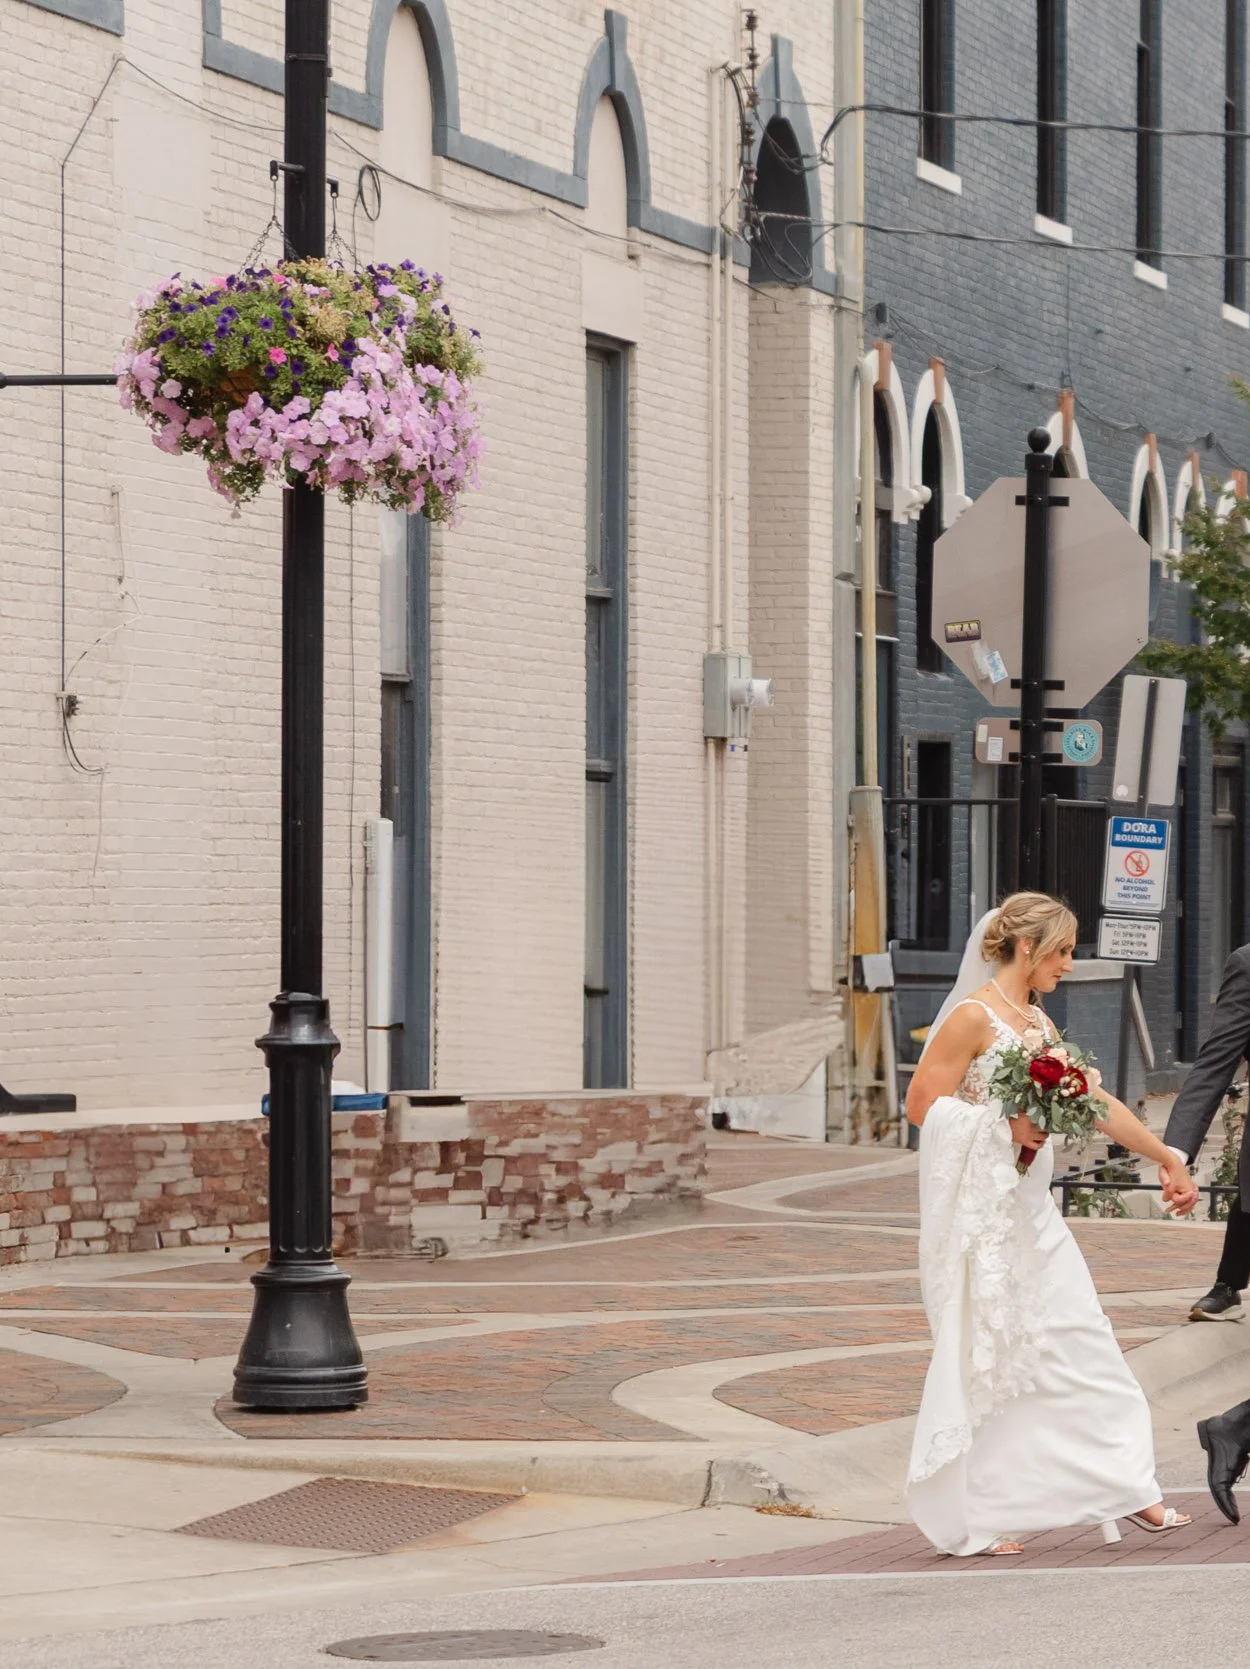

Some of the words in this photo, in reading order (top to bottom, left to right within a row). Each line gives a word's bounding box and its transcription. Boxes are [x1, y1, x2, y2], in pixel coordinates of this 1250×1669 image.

[1123, 822, 1156, 833] DORA
[1115, 834, 1164, 844] BOUNDARY
[1126, 877, 1156, 885] ALCOHOL
